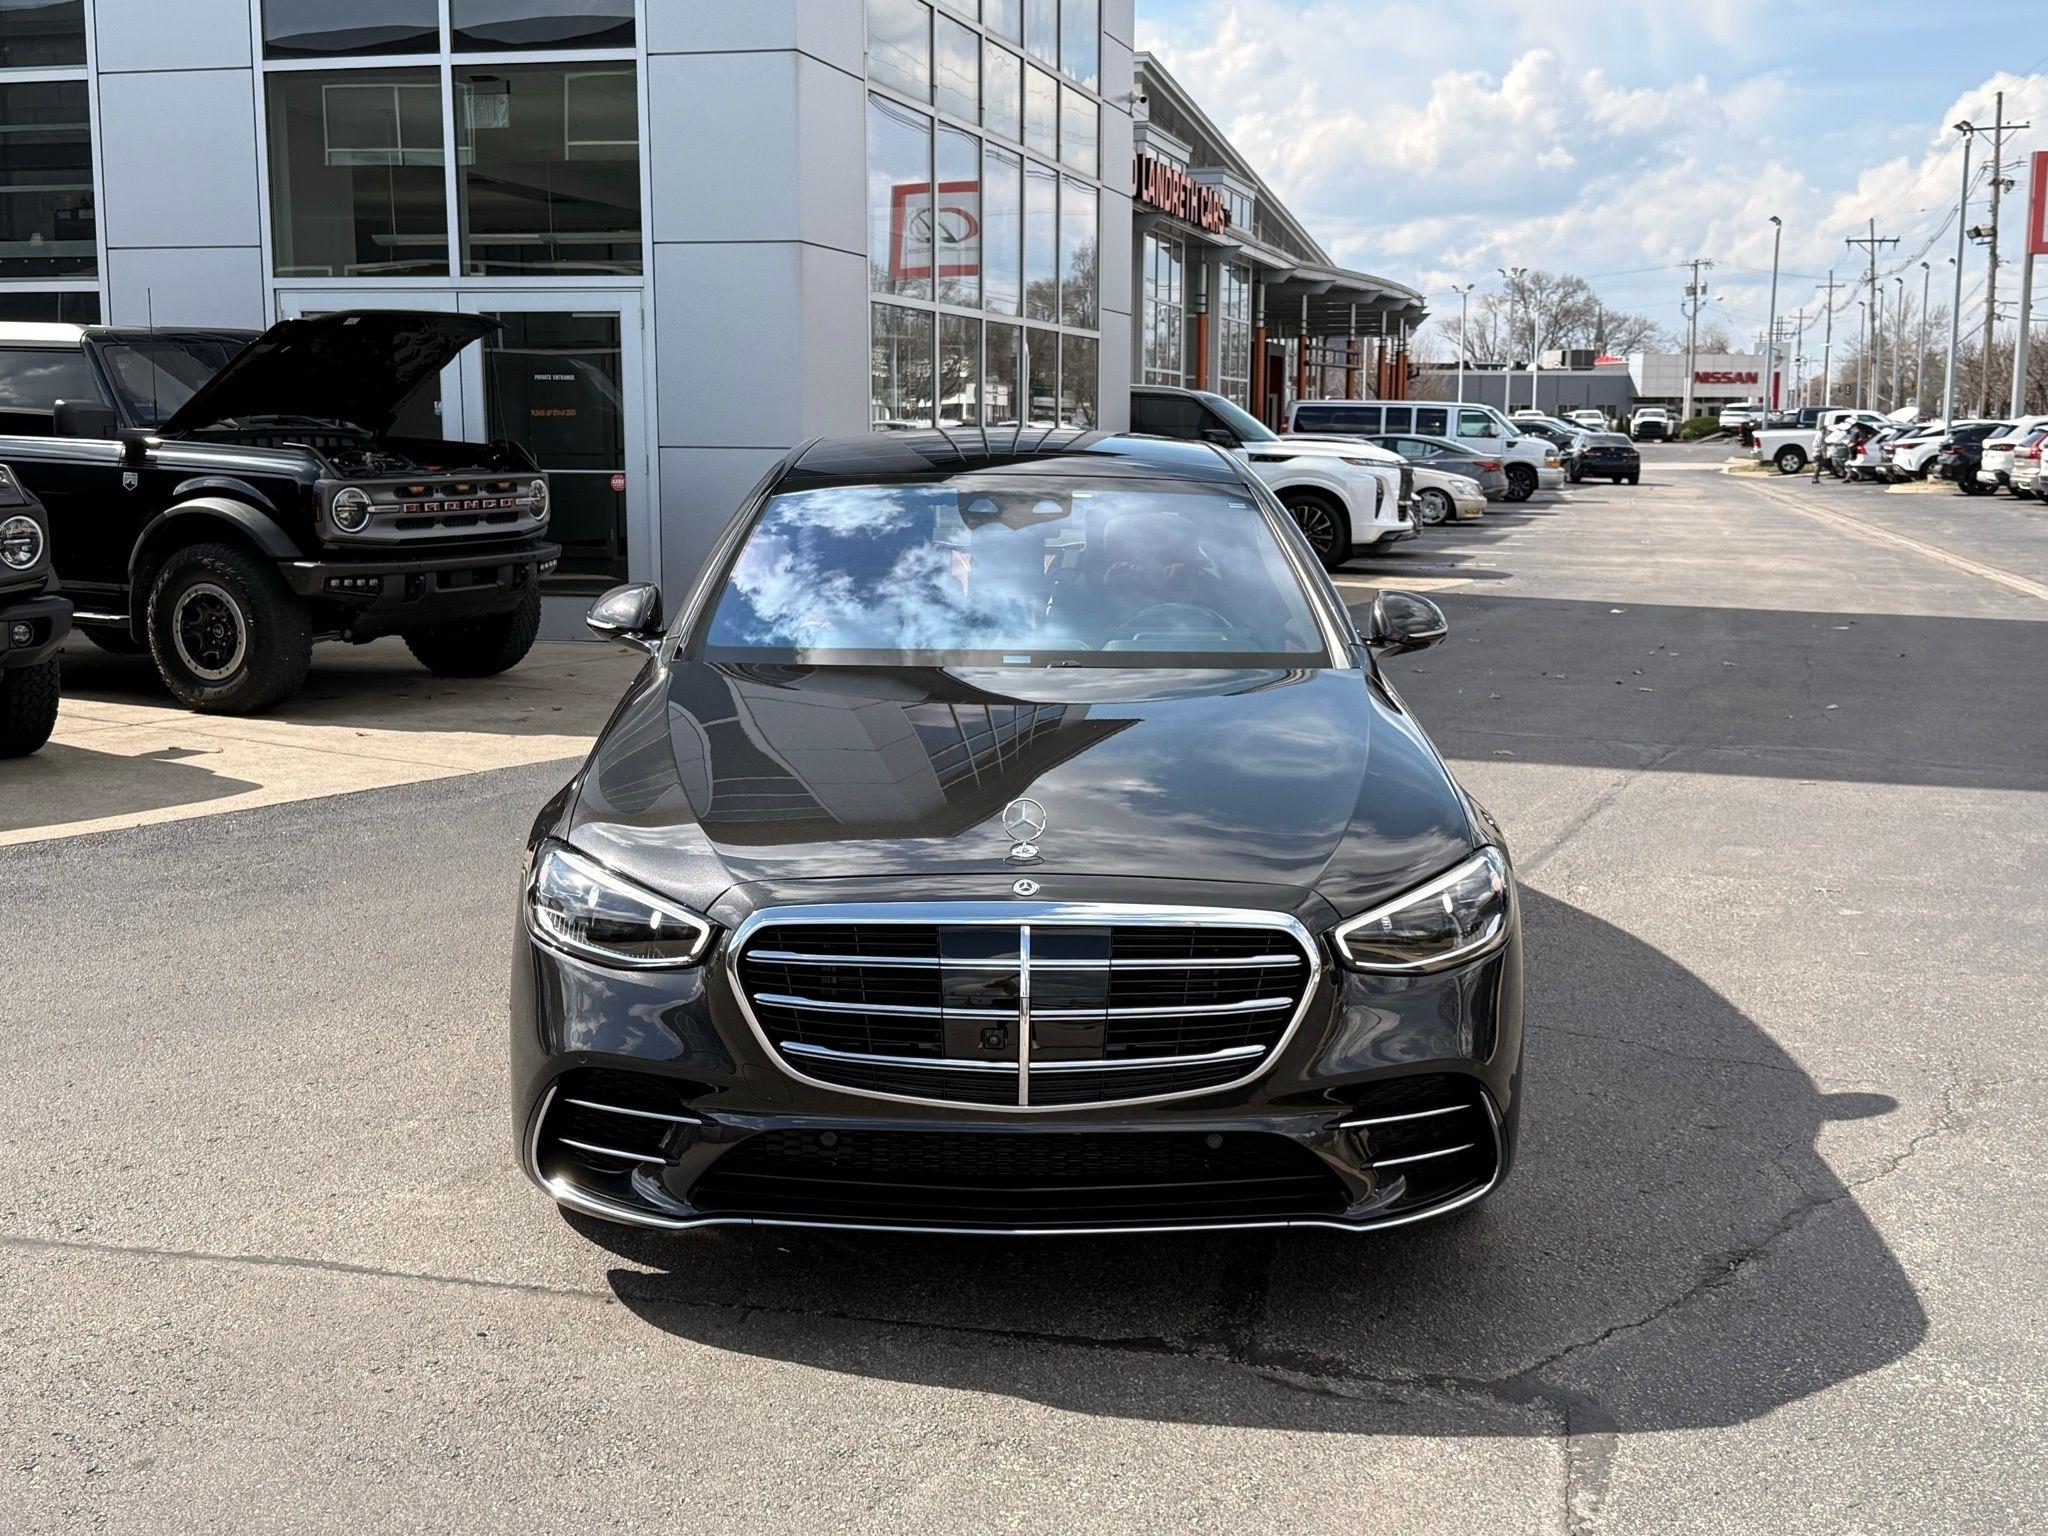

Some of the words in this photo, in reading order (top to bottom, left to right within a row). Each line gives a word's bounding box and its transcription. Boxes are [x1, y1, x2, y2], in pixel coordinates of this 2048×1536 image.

[1142, 153, 1198, 224] LANDRETH
[1201, 186, 1225, 235] CARS
[1693, 371, 1758, 384] NISSAN
[403, 498, 515, 513] BRONCO
